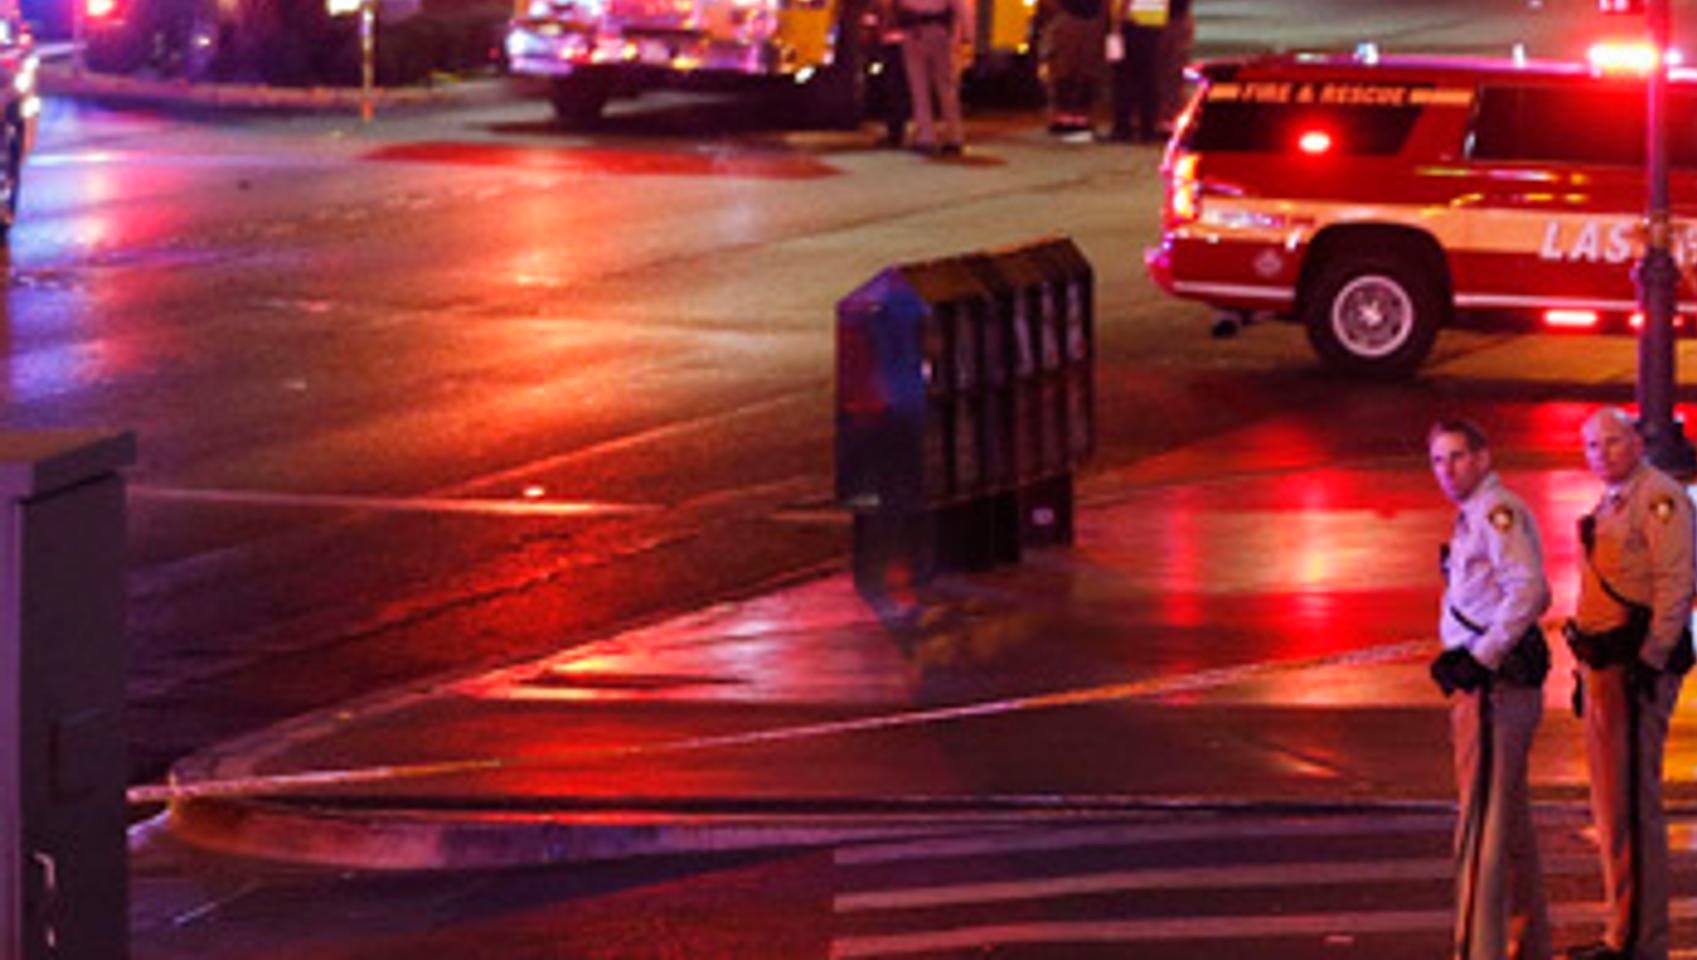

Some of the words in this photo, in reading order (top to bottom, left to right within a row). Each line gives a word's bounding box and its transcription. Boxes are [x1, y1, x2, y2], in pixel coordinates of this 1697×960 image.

[1240, 82, 1293, 104] FIRE
[1294, 84, 1316, 104] &
[1319, 84, 1408, 107] RESCUE
[1539, 220, 1635, 263] LAS
